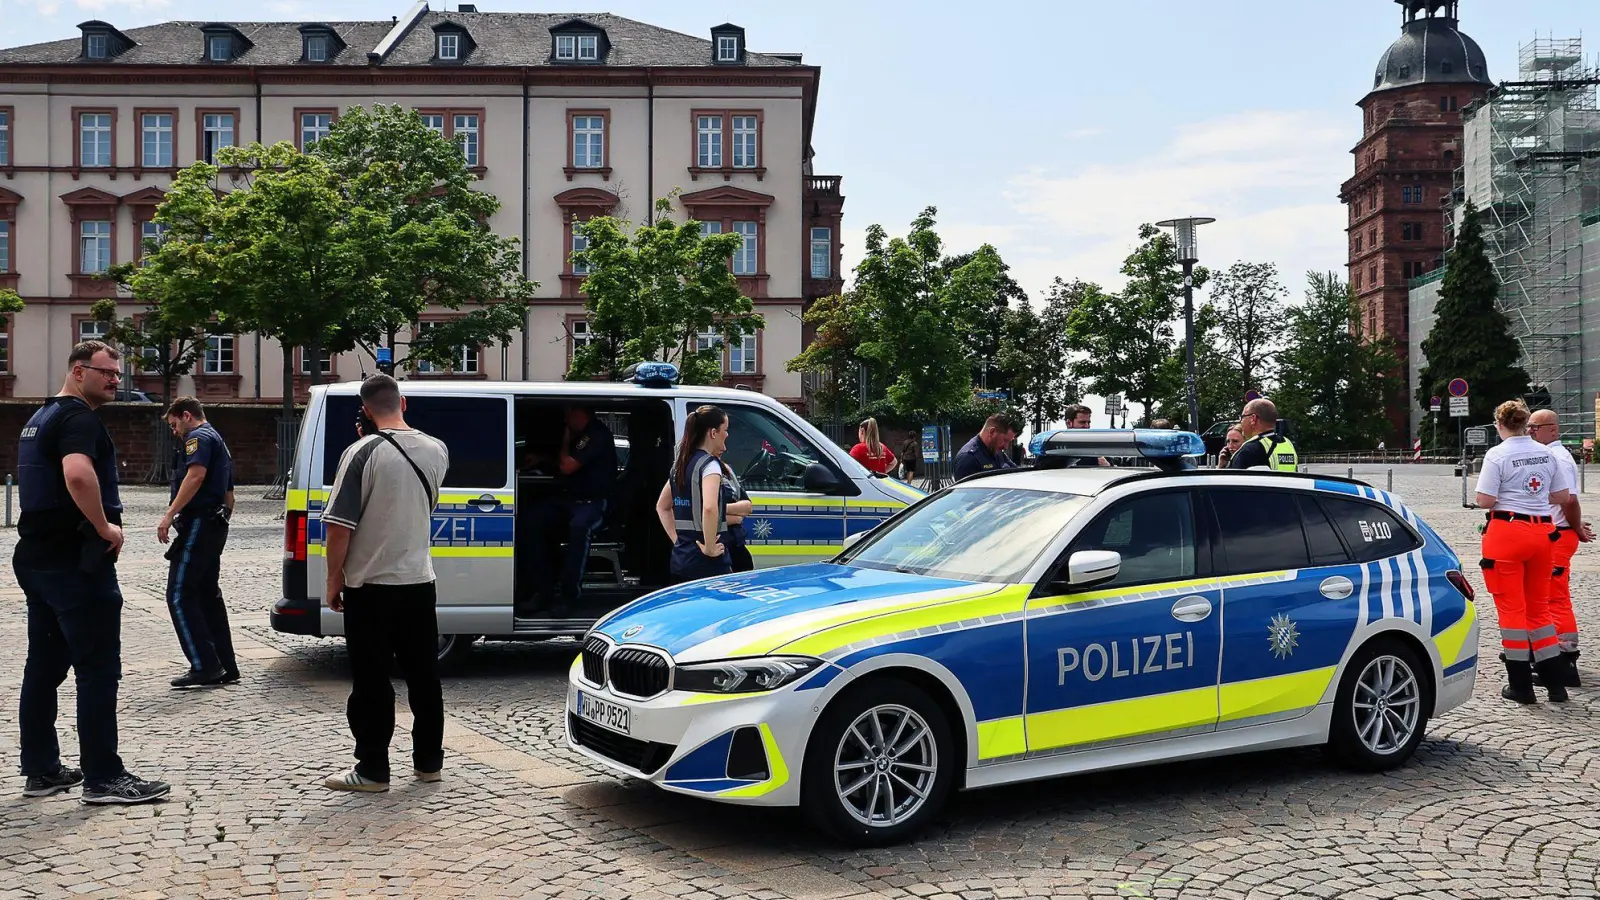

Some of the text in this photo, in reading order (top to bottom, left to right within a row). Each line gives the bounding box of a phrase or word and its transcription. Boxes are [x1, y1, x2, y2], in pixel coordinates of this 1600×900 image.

[1512, 456, 1549, 468] RETTUNGSDIENST
[1371, 521, 1392, 539] 110
[1057, 631, 1194, 686] POLIZEI
[595, 700, 606, 722] PP
[606, 704, 629, 730] 9521
